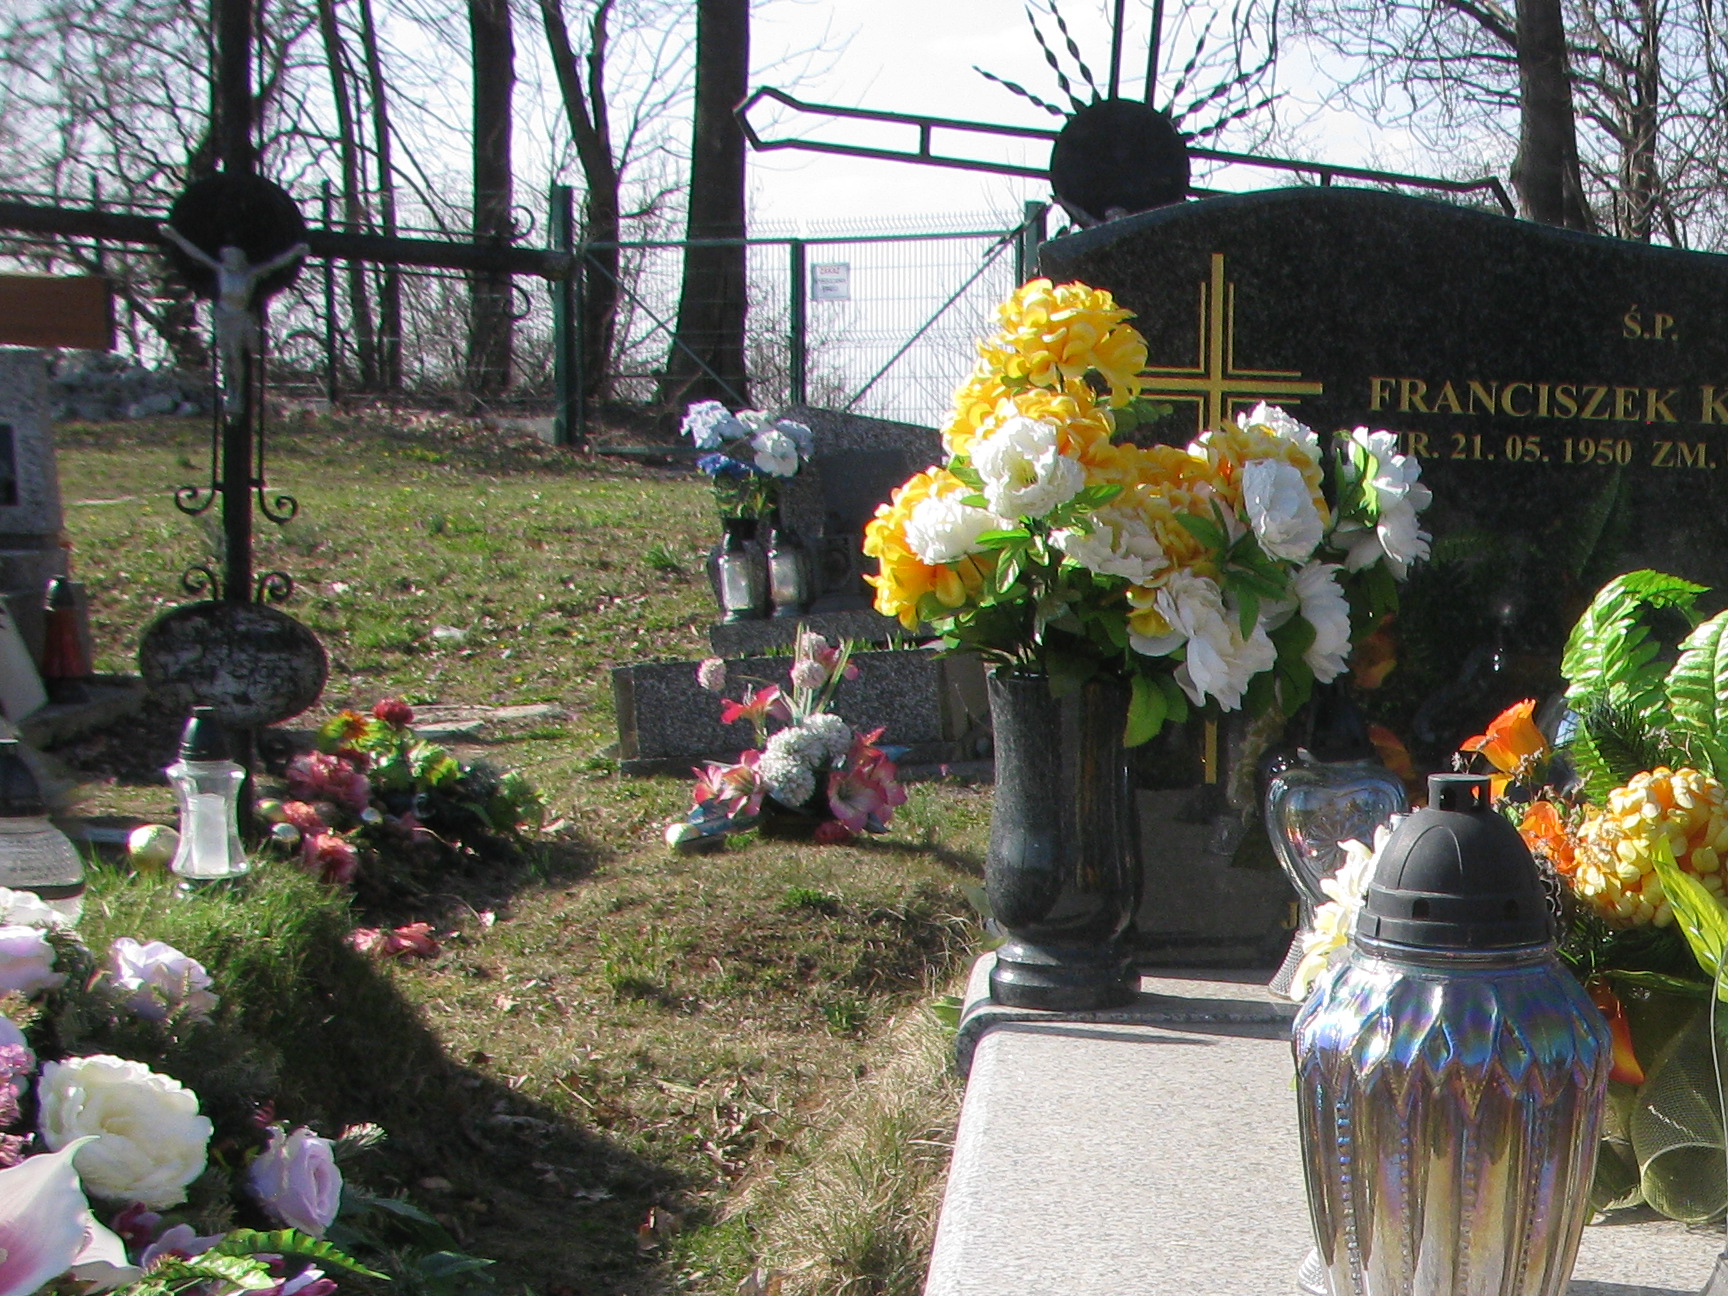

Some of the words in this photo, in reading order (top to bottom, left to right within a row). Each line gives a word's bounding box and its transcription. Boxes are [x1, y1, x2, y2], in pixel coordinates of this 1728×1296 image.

[1622, 304, 1679, 341] Ś.P.
[1369, 375, 1679, 425] FRANCISZEK
[1450, 431, 1496, 461] 21.
[1504, 434, 1550, 463] 05.
[1563, 436, 1634, 466] 1950
[1651, 440, 1718, 470] ZM.
